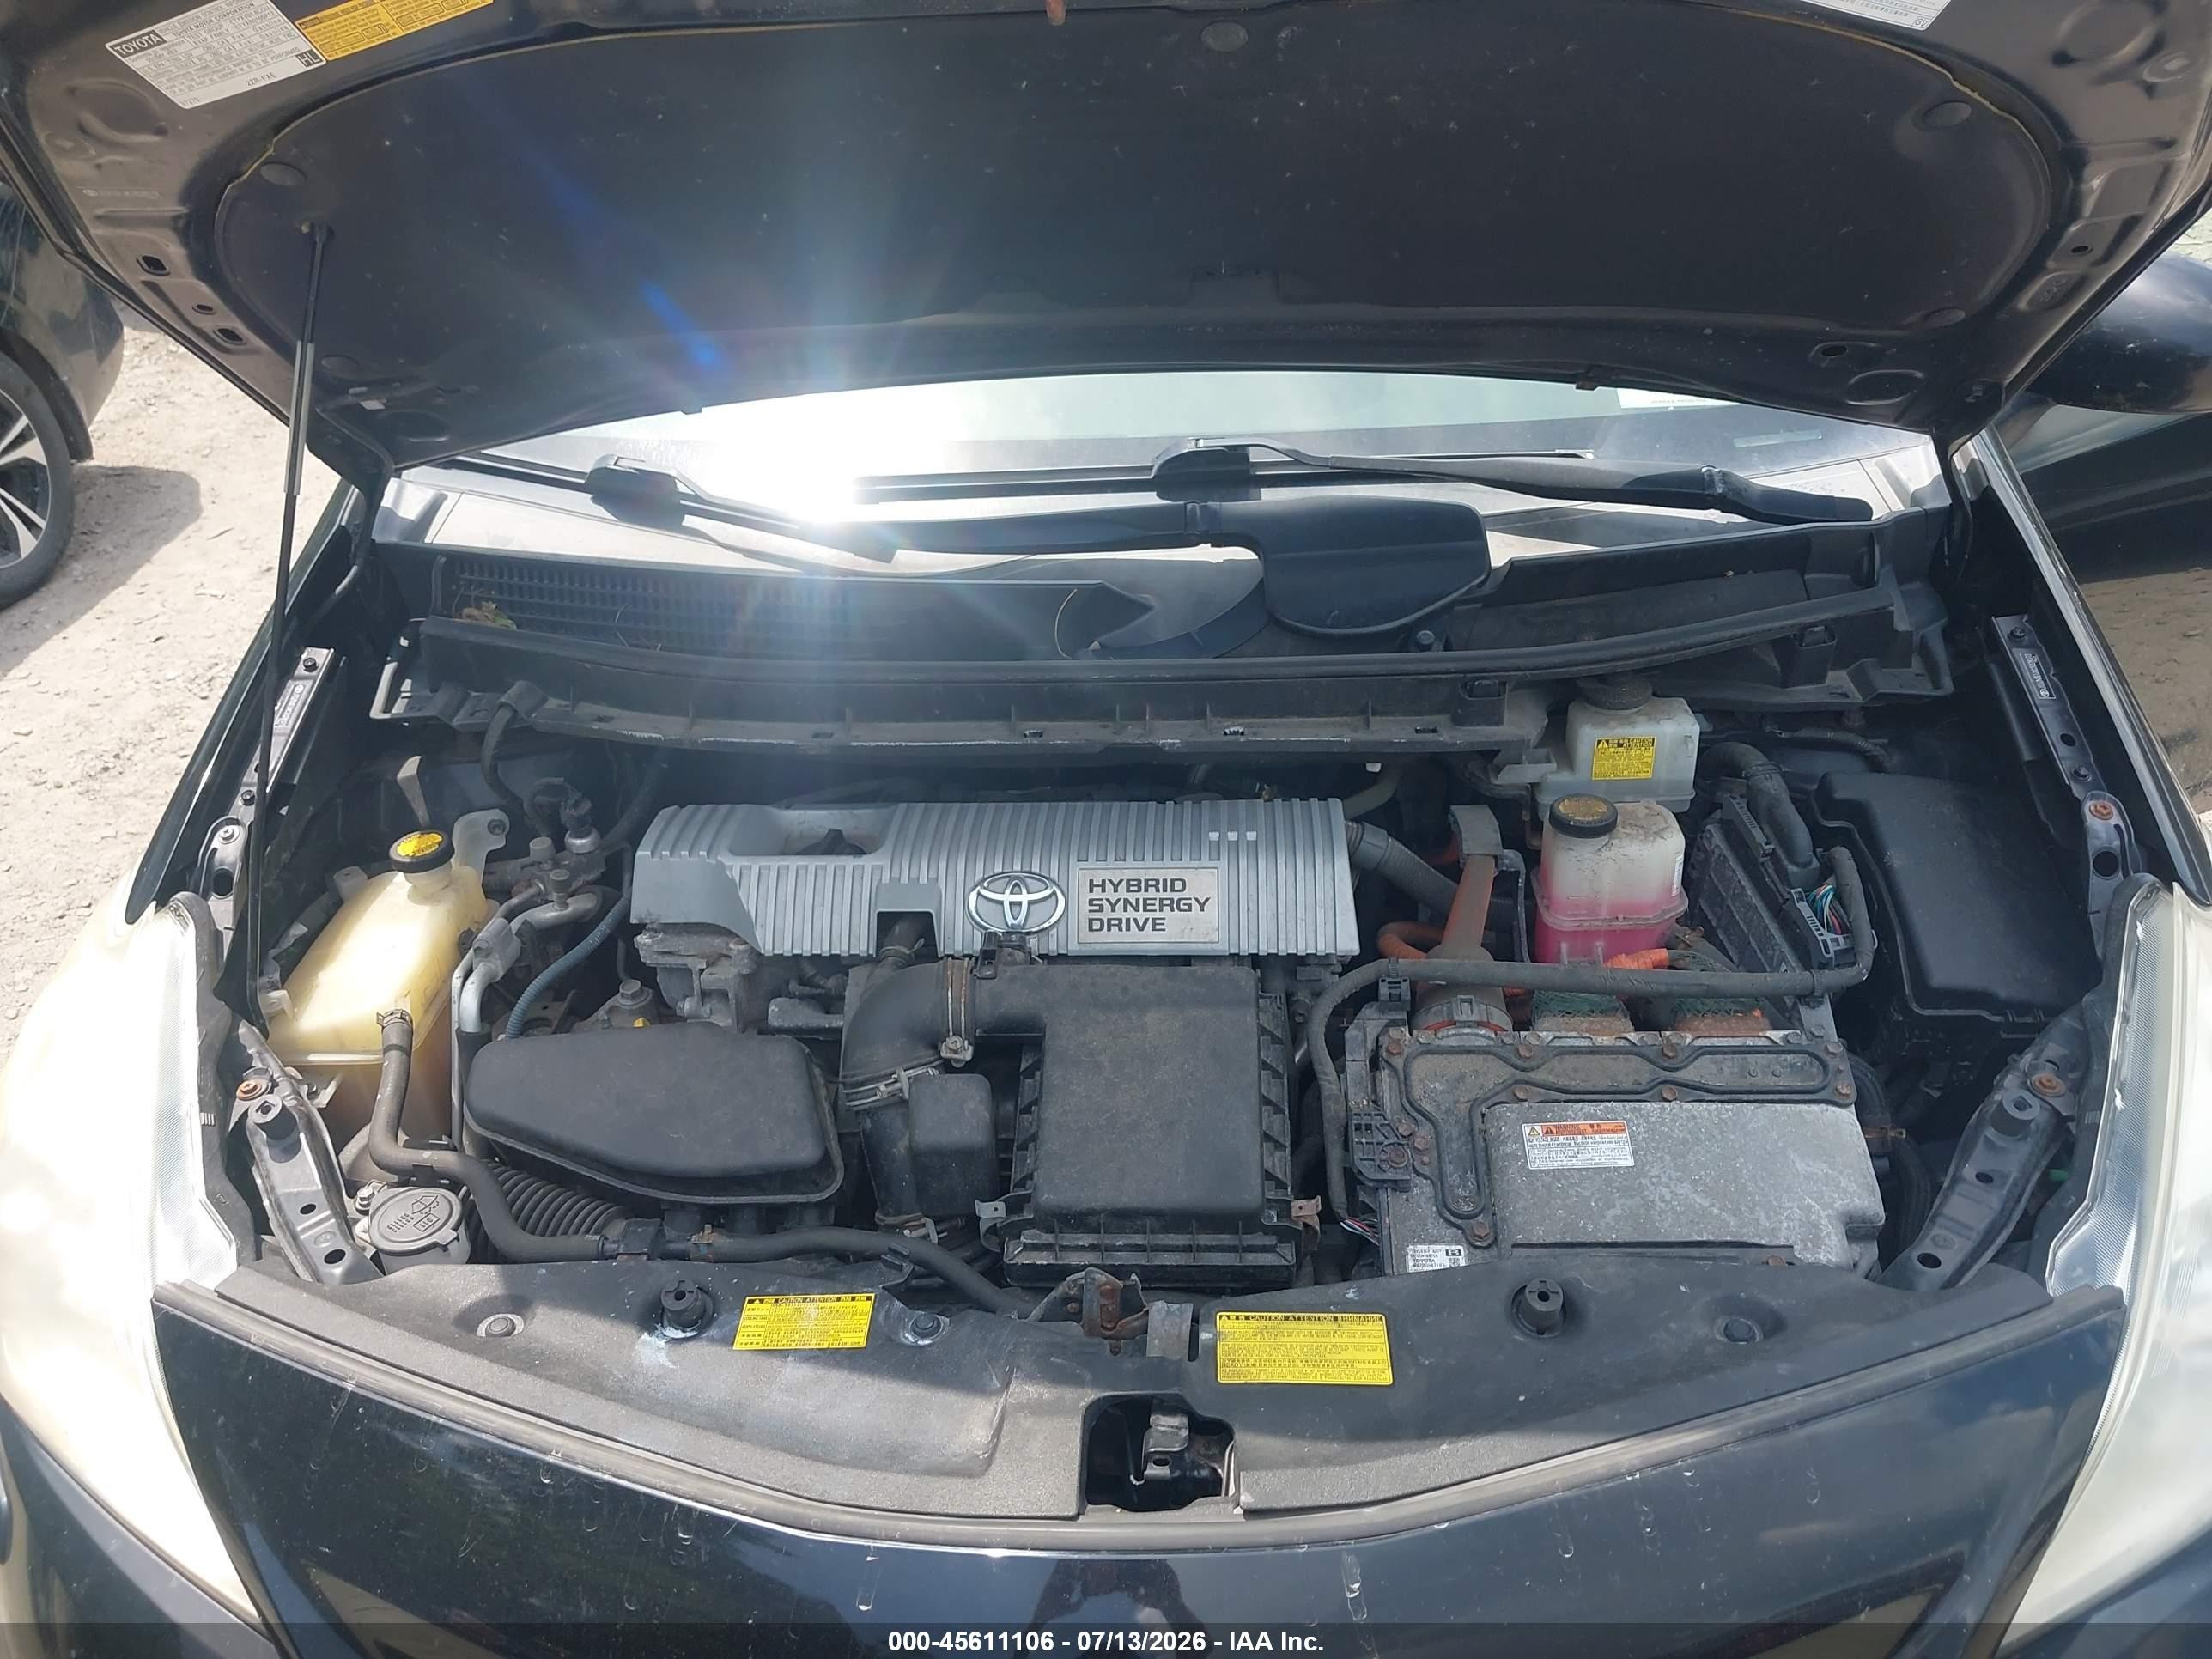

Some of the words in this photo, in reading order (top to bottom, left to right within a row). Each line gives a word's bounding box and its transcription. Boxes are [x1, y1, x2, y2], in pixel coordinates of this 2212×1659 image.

[171, 26, 194, 37] TOYOTA
[191, 18, 215, 29] MOTOR
[213, 2, 256, 21] CORPORATION
[114, 33, 163, 55] TOYOTA
[296, 52, 320, 67] HL
[1088, 878, 1187, 894] HYBRID
[1087, 896, 1212, 913] SYNERGY
[1087, 917, 1166, 933] DRIVE
